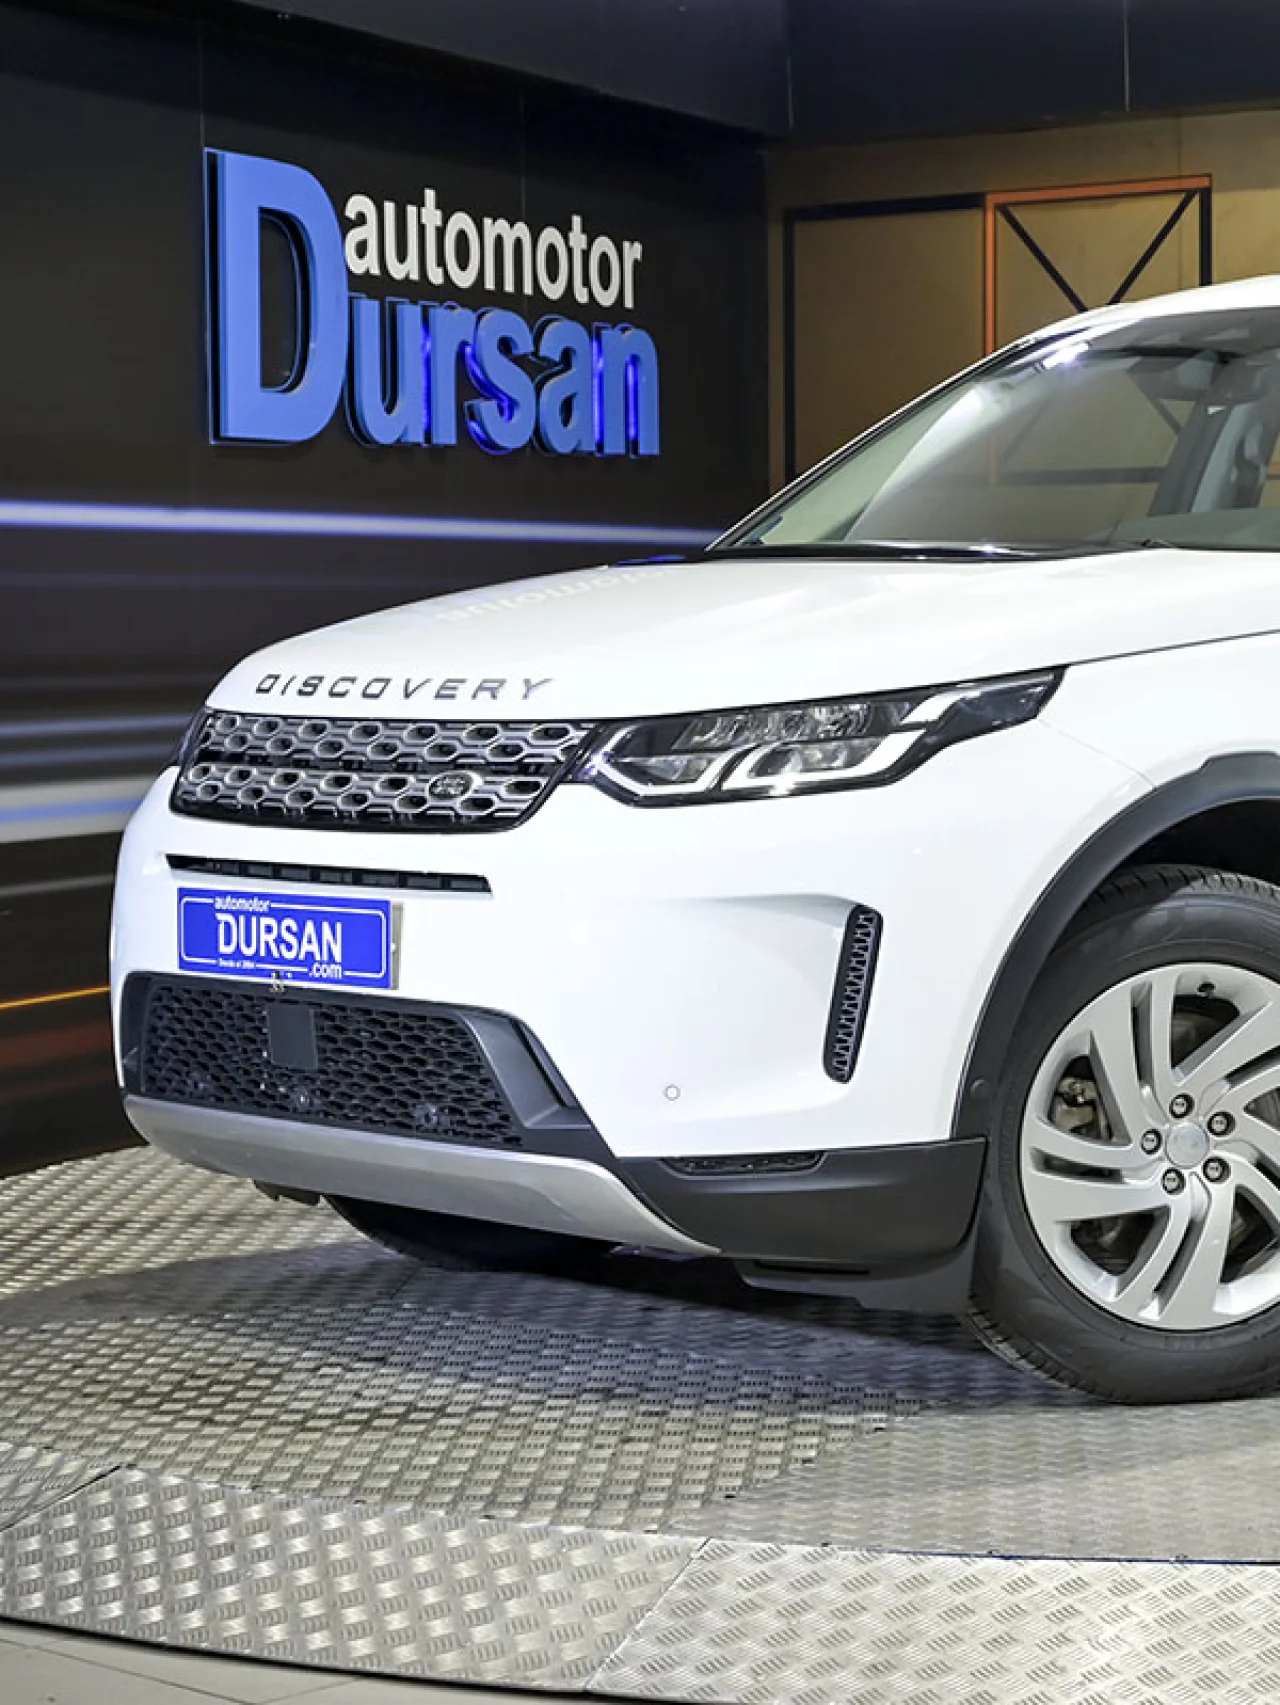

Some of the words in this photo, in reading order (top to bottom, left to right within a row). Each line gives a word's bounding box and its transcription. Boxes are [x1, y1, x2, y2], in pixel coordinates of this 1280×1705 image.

[344, 187, 642, 308] automotor
[205, 147, 660, 458] Dursan
[255, 673, 554, 700] DISCOVERY
[215, 912, 343, 963] DURSAN
[308, 962, 343, 979] .com
